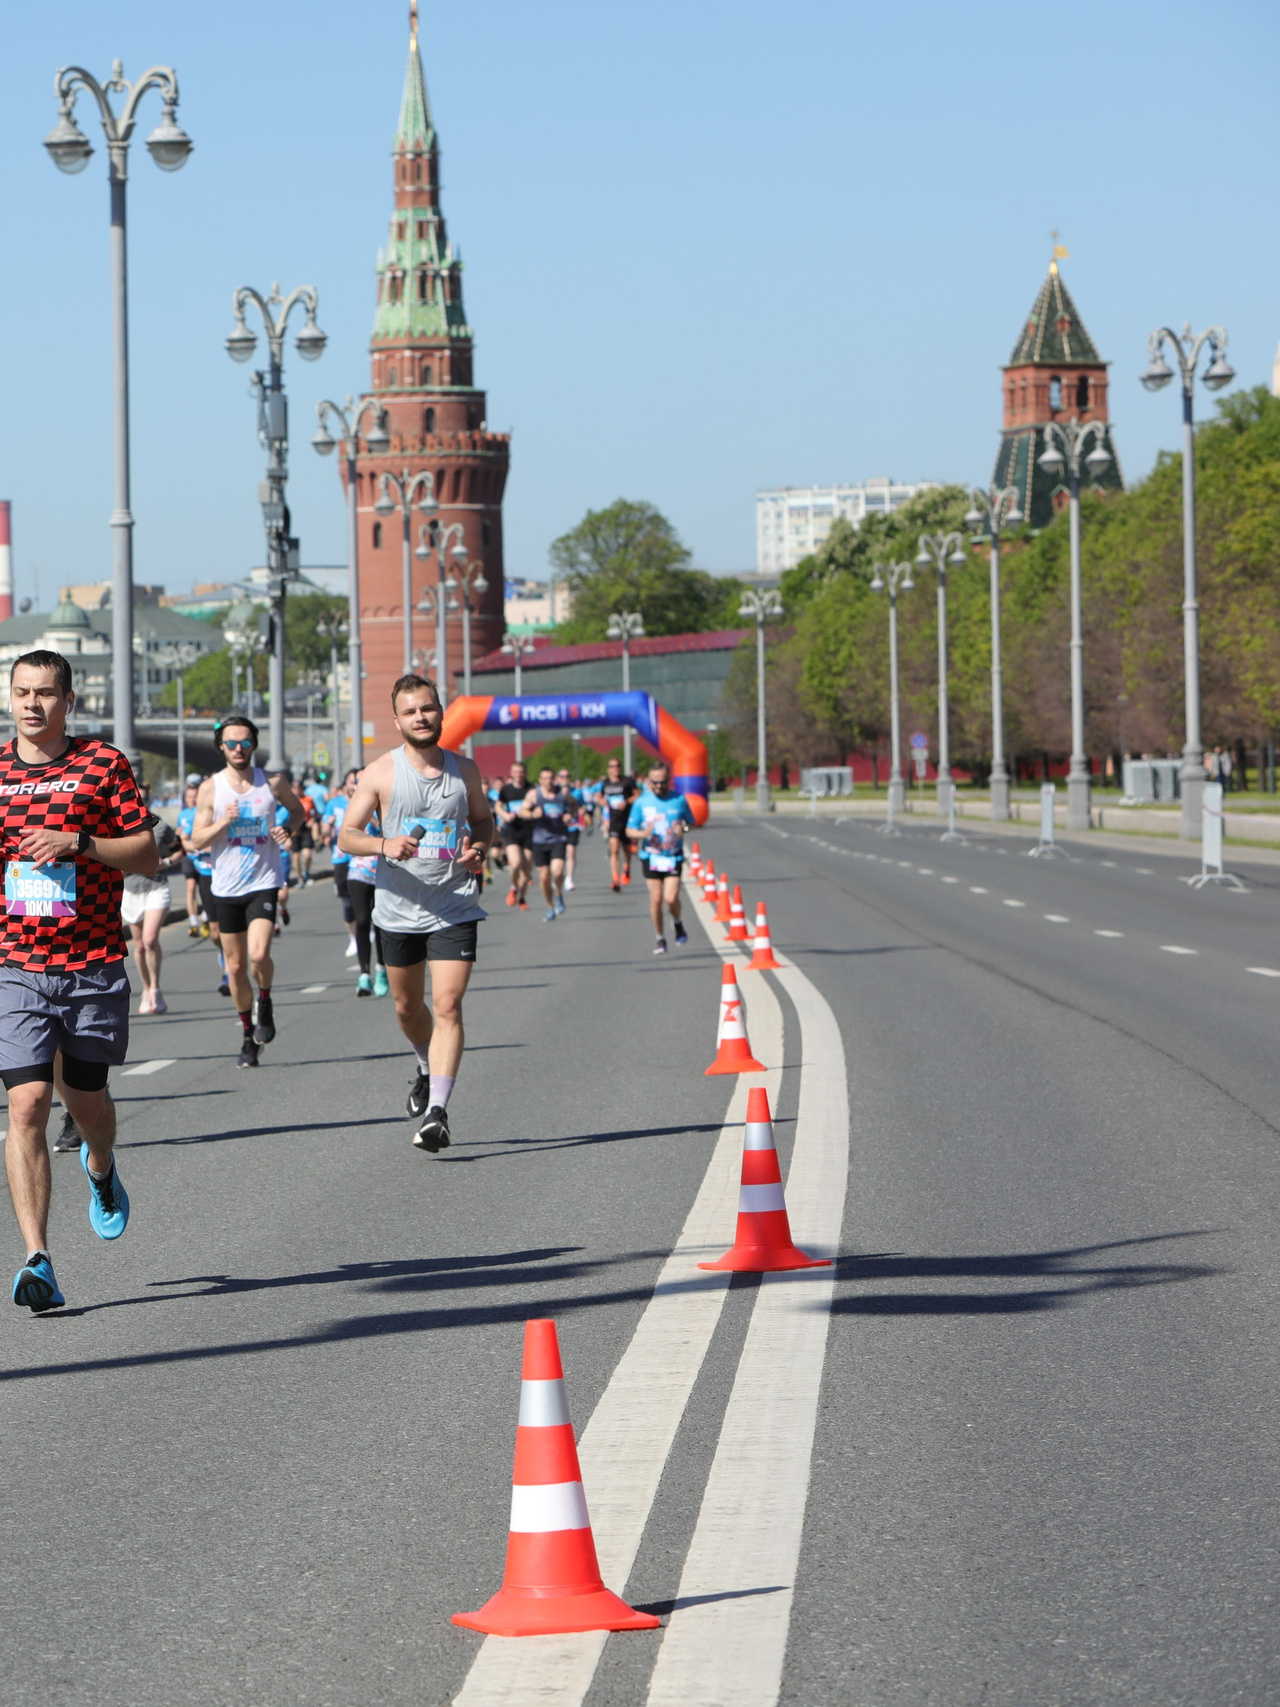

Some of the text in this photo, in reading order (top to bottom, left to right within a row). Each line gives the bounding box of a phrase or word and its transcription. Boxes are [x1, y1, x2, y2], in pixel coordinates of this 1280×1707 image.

[522, 705, 559, 720] ПСБ
[17, 879, 61, 899] 35697
[24, 900, 53, 916] 10КМ
